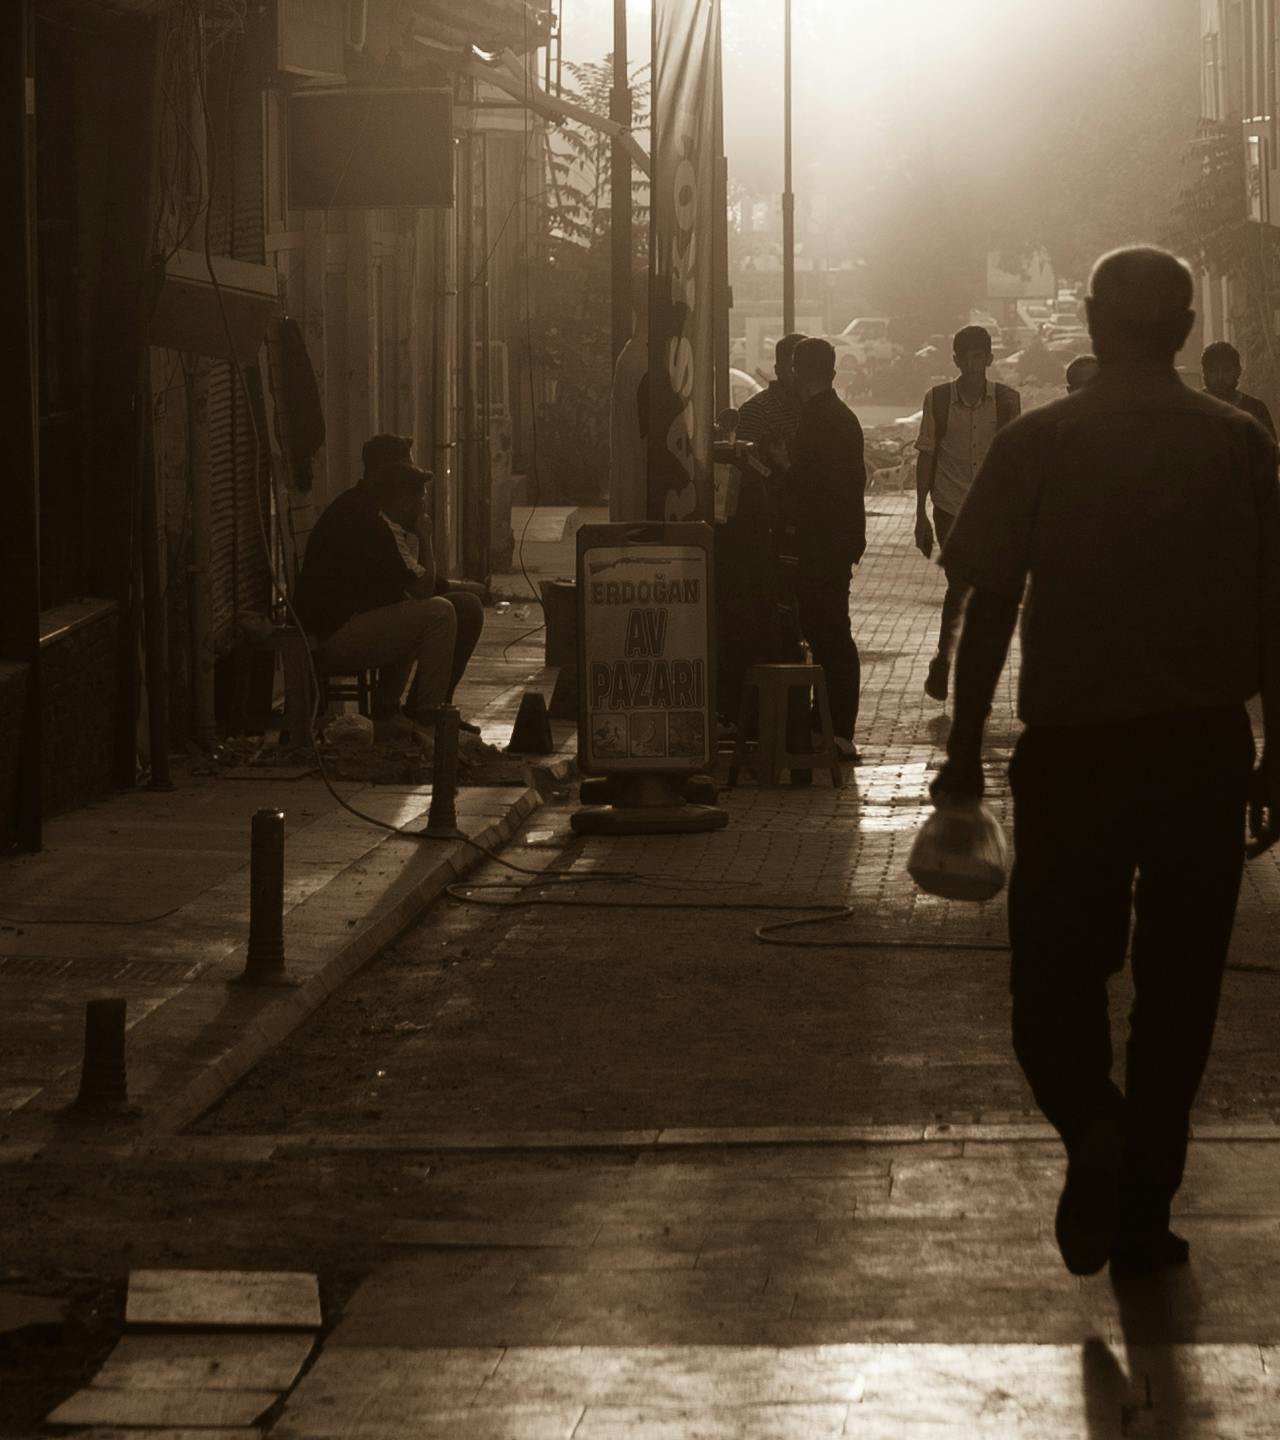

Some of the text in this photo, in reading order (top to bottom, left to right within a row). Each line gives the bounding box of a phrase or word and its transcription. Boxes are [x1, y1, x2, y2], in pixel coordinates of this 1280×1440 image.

[591, 573, 700, 604] ERDOĞAN
[625, 608, 668, 657] AV
[590, 659, 704, 709] PAZARI
